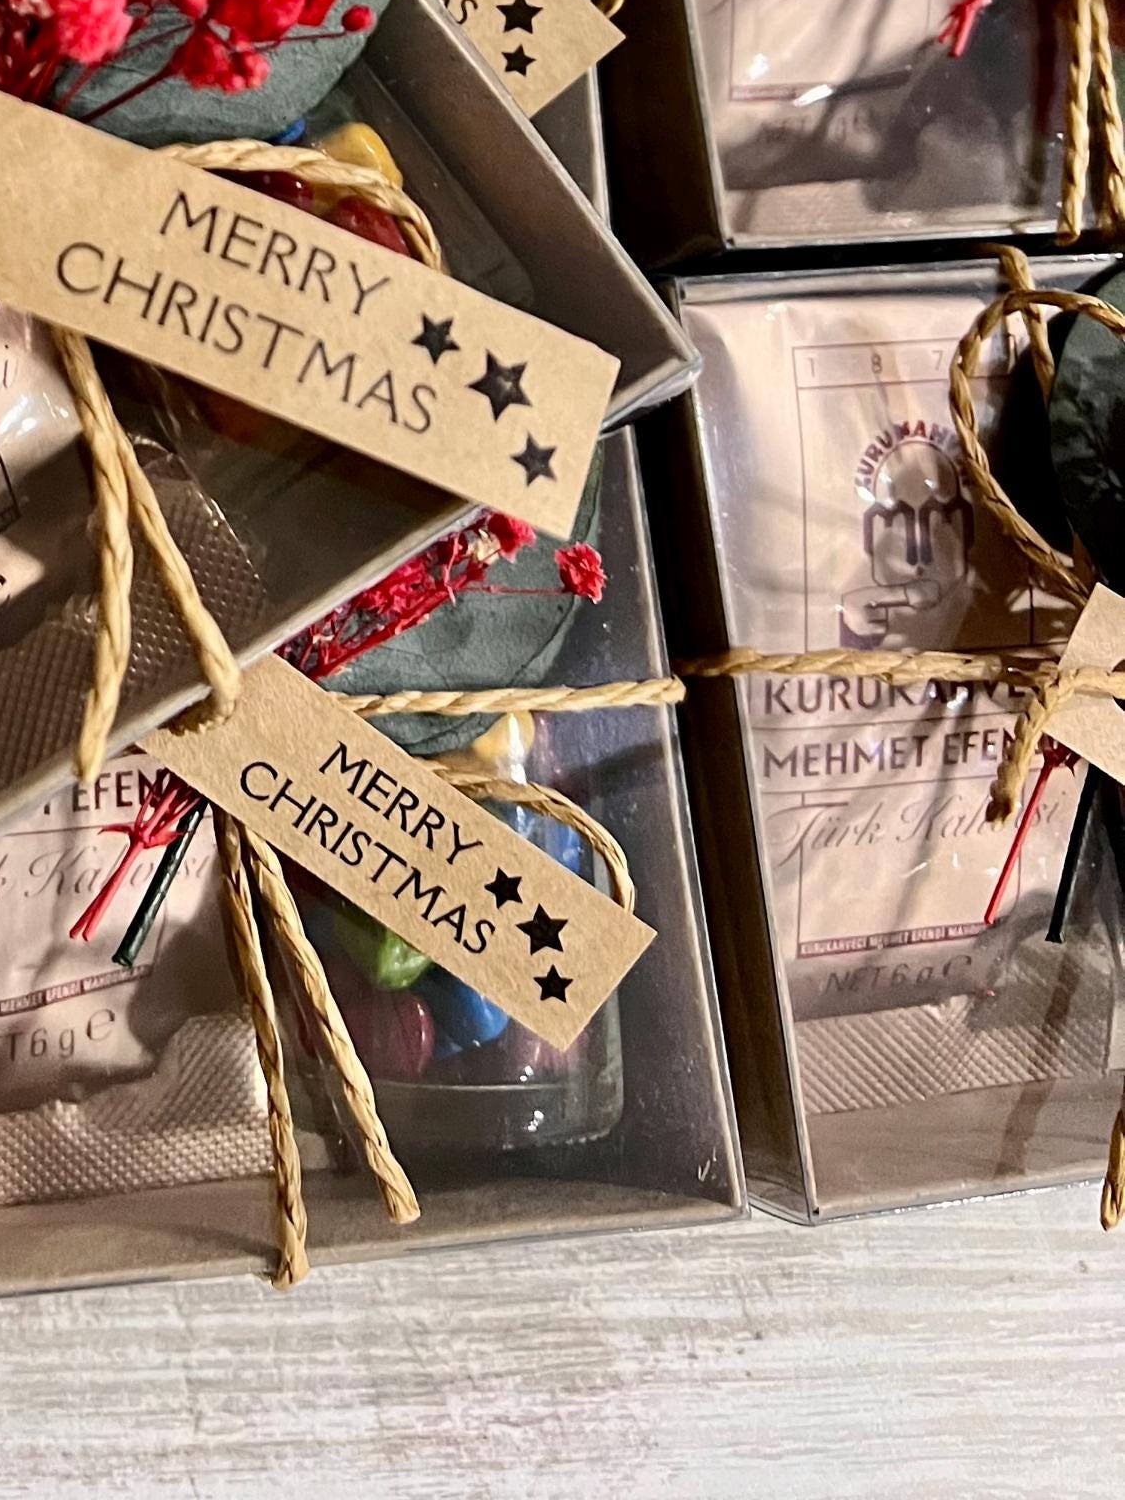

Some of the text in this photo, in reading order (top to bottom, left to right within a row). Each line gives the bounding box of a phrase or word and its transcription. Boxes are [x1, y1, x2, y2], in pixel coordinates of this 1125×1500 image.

[158, 190, 391, 317] MERRY
[56, 241, 438, 435] CHRISTMAS
[71, 767, 166, 813] EFEN
[318, 740, 484, 866] MERRY
[762, 734, 930, 778] MEHMET
[239, 761, 496, 955] CHRISTMAS
[30, 1026, 48, 1059] 6
